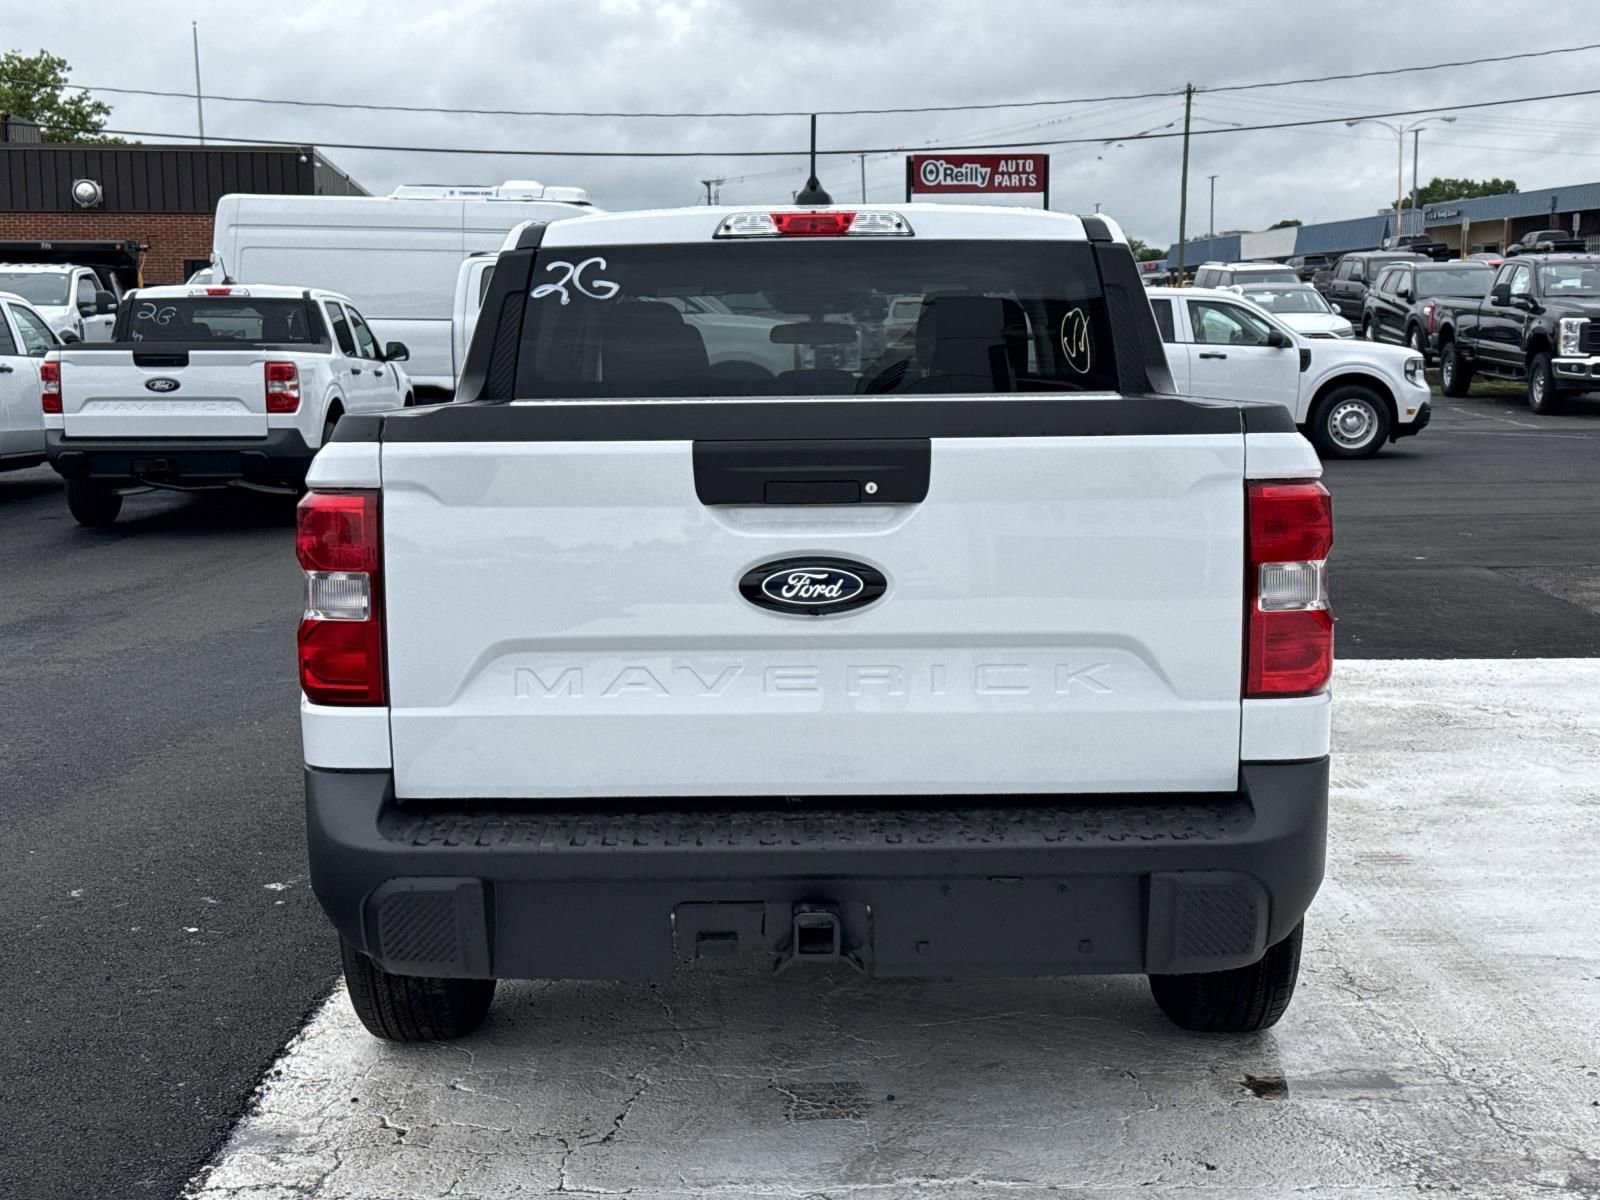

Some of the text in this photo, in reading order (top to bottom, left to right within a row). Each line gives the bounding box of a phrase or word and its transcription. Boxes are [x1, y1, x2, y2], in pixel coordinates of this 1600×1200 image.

[921, 160, 990, 187] O'Reilly
[999, 159, 1034, 172] AUTO
[994, 174, 1037, 187] PARTS
[92, 402, 237, 412] MAVERICK
[781, 572, 844, 598] Ford
[514, 663, 1113, 698] MAVERICK
